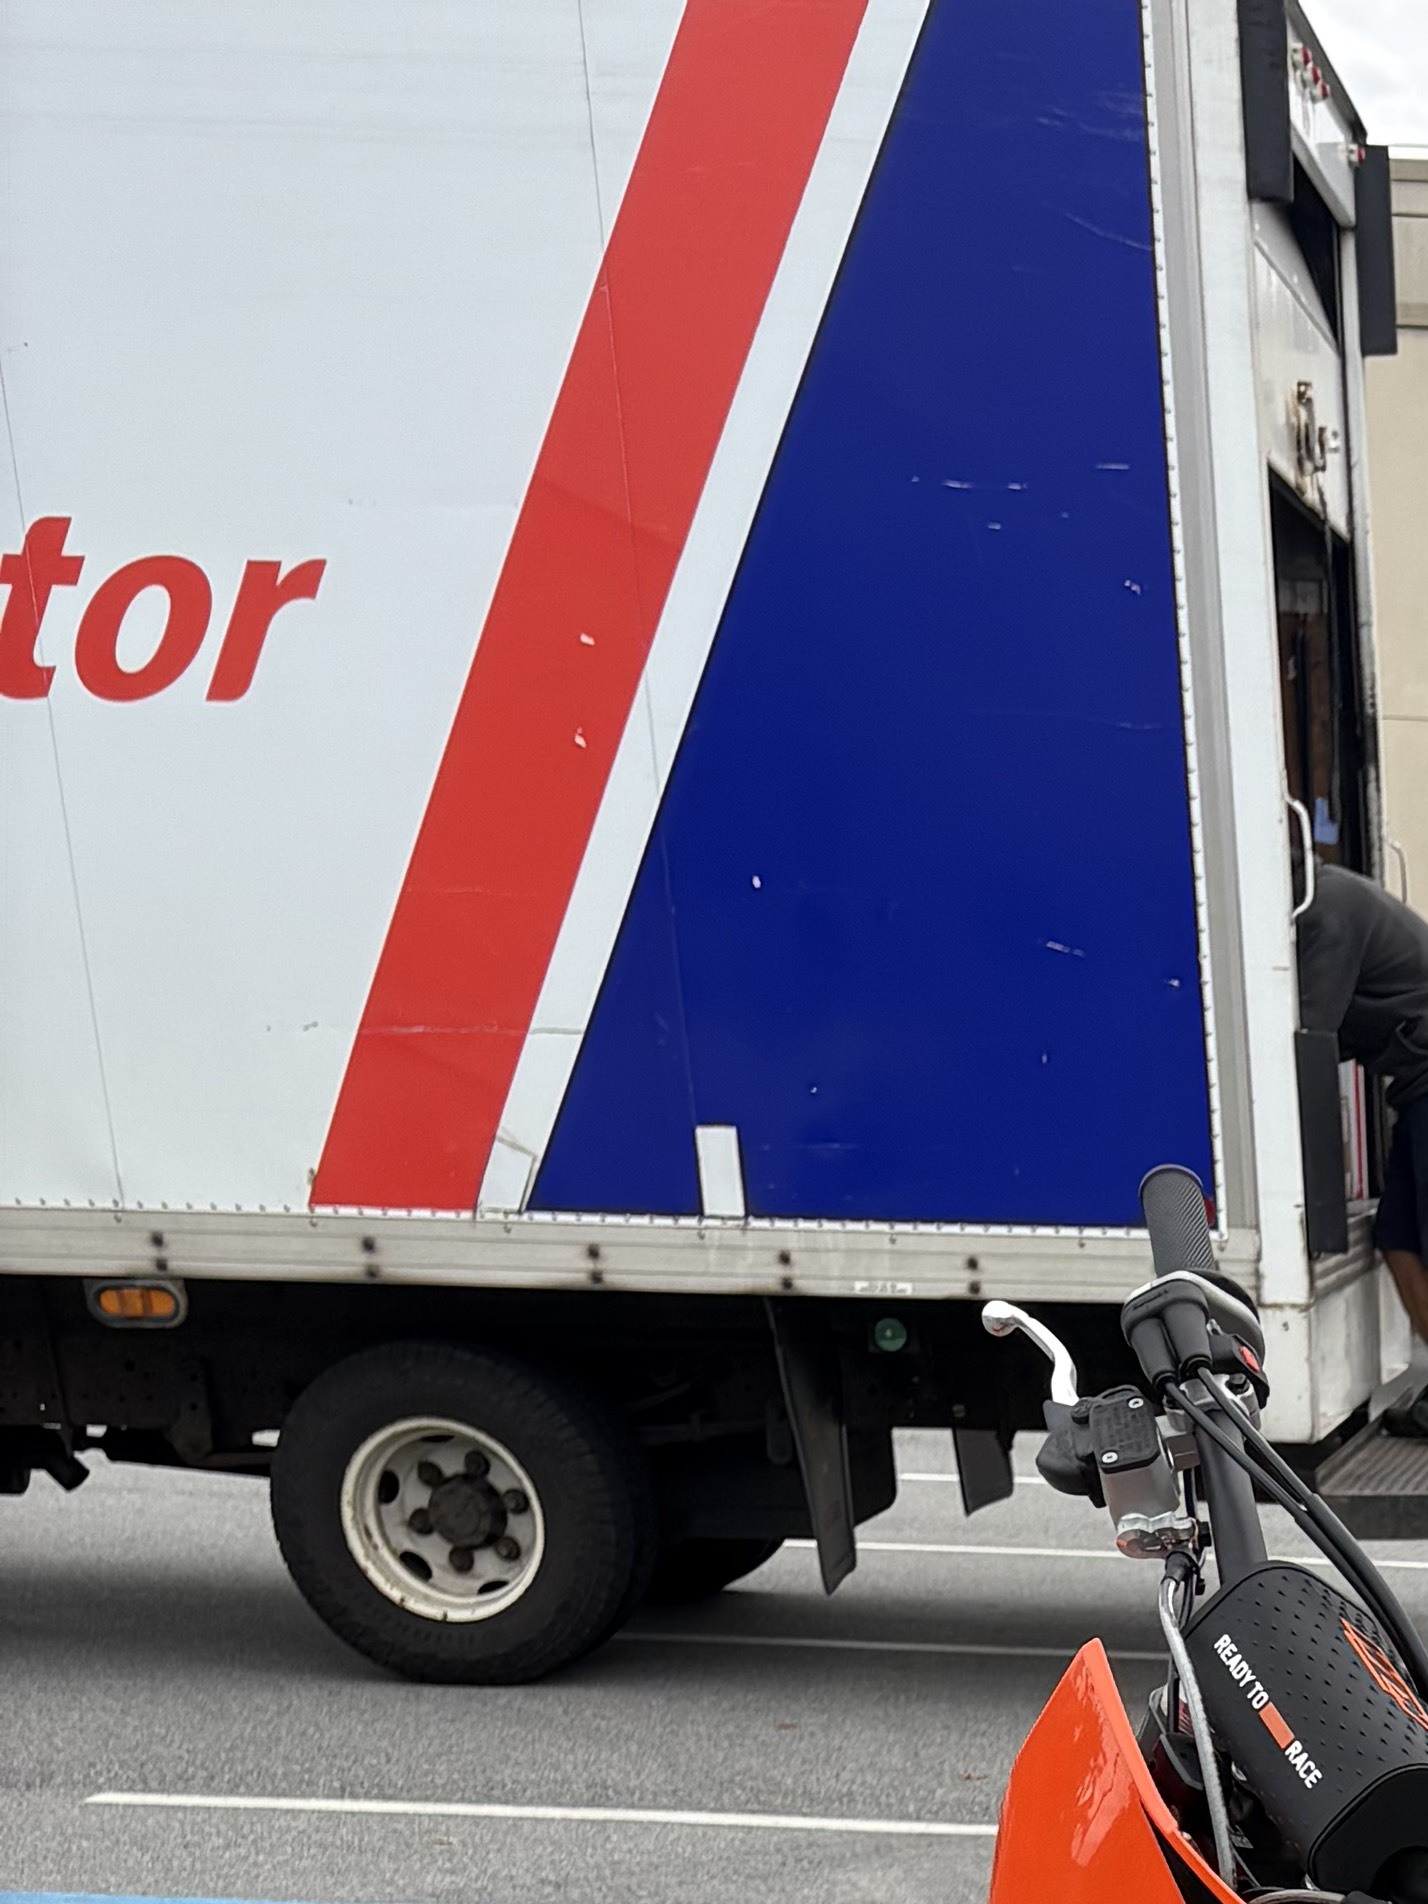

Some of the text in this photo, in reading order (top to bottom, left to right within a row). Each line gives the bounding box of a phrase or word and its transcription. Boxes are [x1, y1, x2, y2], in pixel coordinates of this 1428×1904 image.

[1213, 1633, 1323, 1789] READY TO RACE
